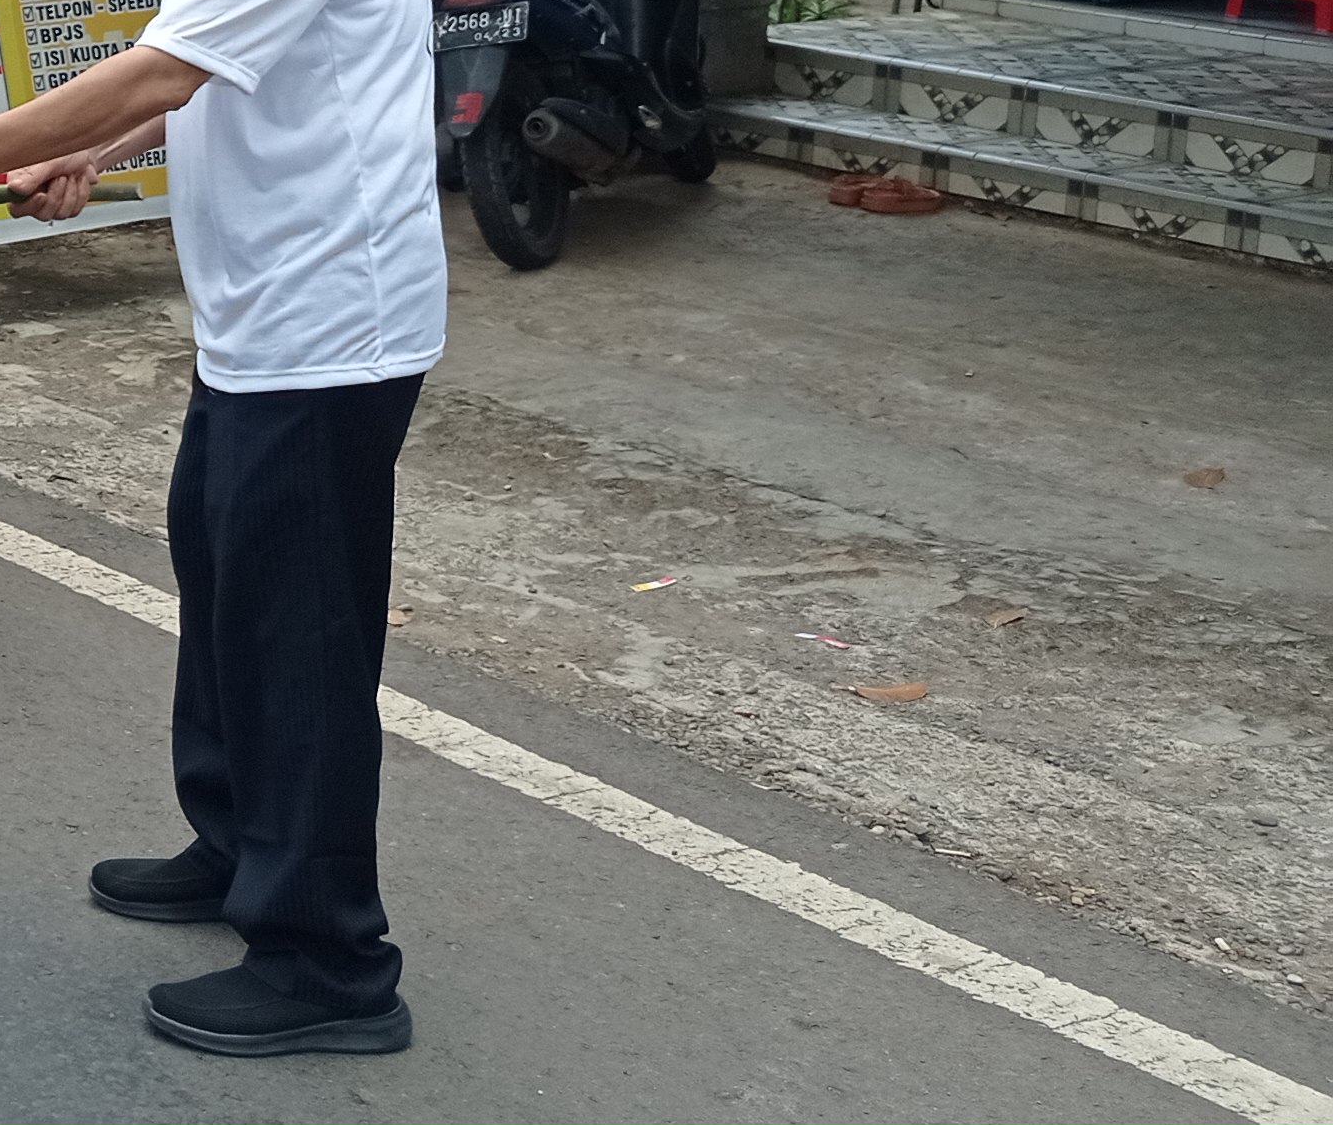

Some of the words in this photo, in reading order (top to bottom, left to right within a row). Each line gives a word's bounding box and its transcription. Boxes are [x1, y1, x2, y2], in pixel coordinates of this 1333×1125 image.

[36, 0, 93, 22] TELPON
[40, 24, 84, 44] BPJS
[44, 49, 65, 67] ISI
[70, 44, 119, 64] KUOTA
